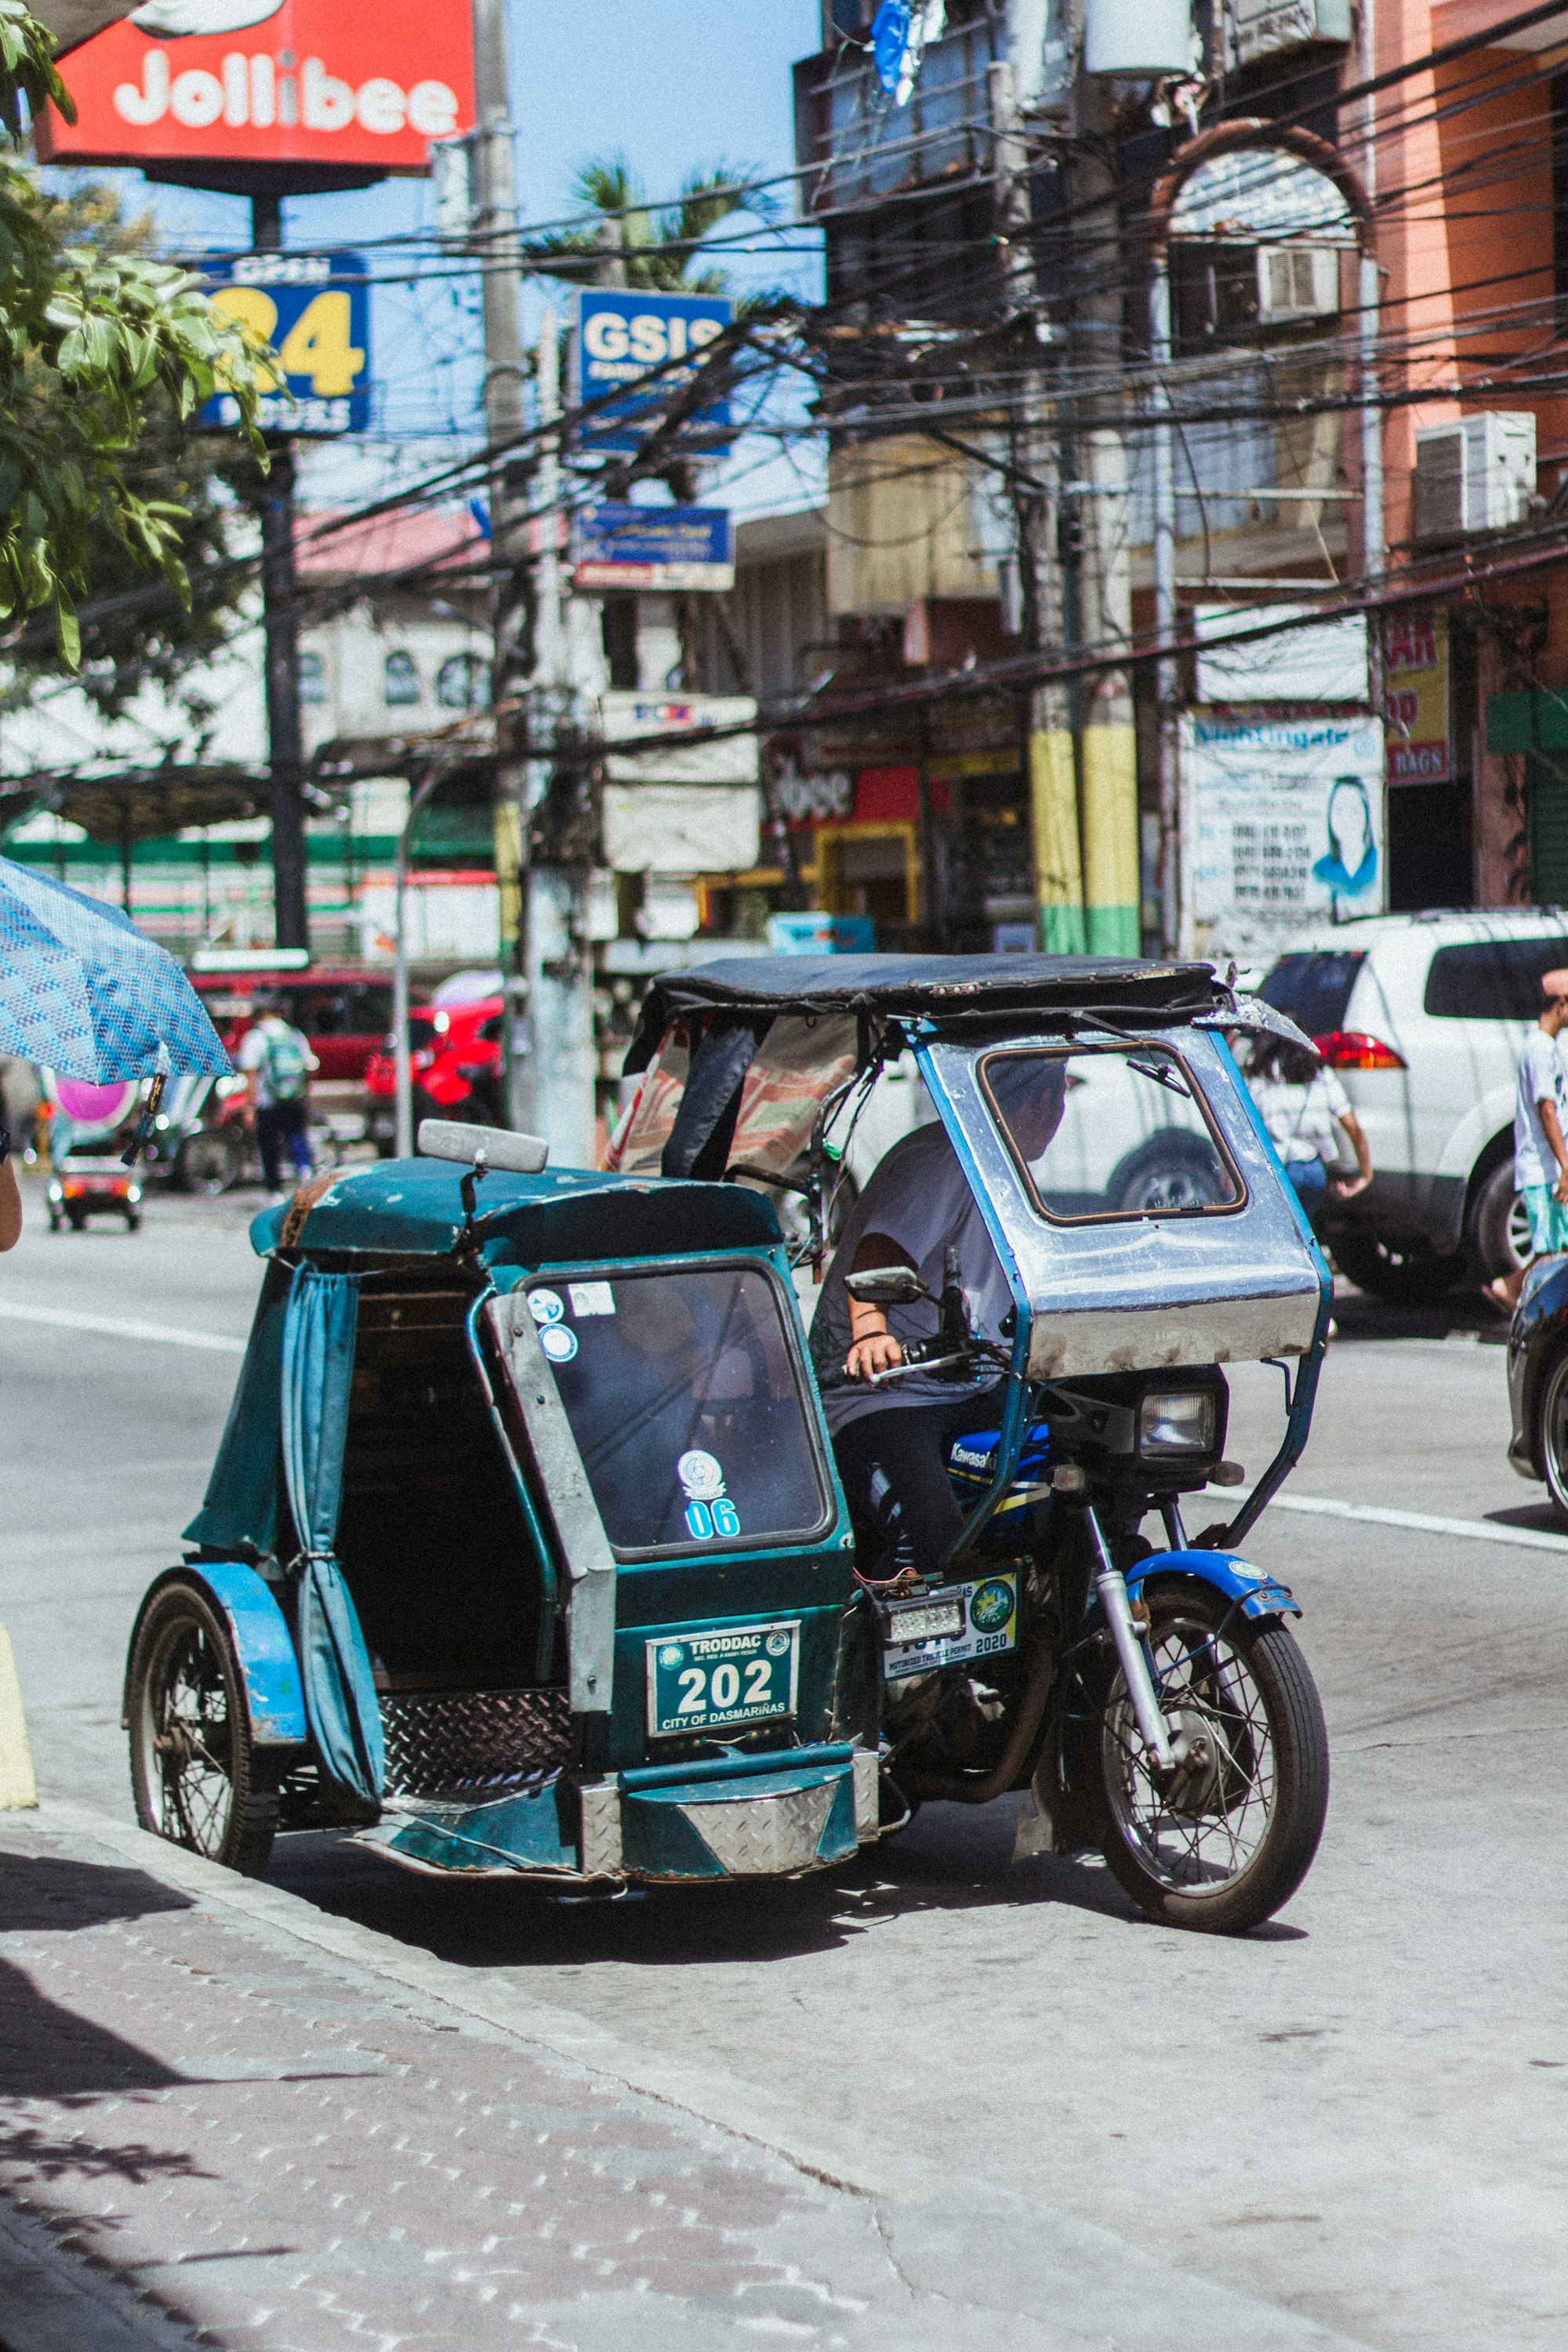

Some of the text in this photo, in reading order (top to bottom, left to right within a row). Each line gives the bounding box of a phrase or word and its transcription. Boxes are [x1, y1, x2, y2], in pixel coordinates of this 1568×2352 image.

[113, 48, 459, 136] Jollibee
[685, 1498, 741, 1541] 06
[690, 1635, 761, 1655] TRODDAC
[889, 1656, 921, 1671] MOTORIZED
[949, 1644, 971, 1656] PERMIT
[975, 1634, 1007, 1653] 2020
[677, 1659, 772, 1714] 202
[662, 1702, 786, 1730] CITY OF DASMARIÑAS
